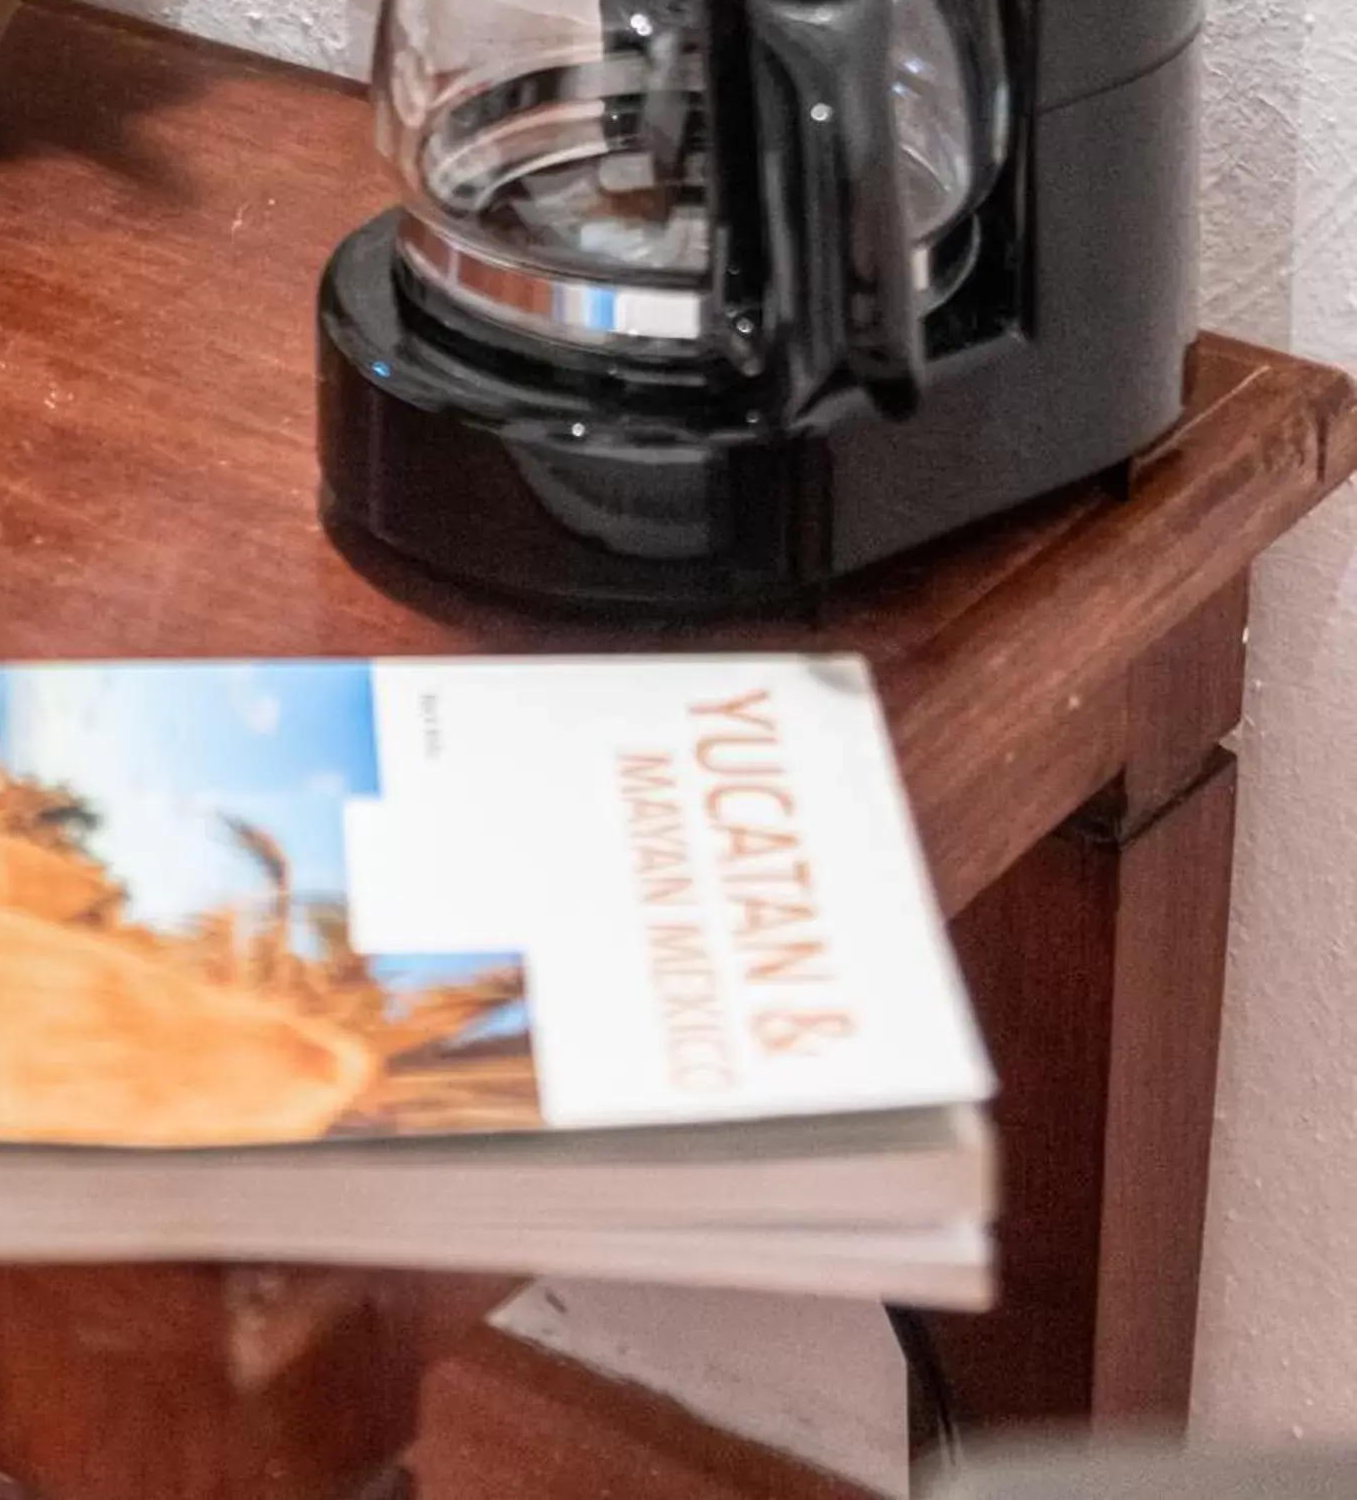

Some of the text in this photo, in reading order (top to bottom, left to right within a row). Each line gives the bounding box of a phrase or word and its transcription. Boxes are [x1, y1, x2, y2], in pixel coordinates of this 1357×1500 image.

[616, 749, 737, 1096] MAYAN MEXICO
[686, 688, 857, 1058] YUCATAN &
